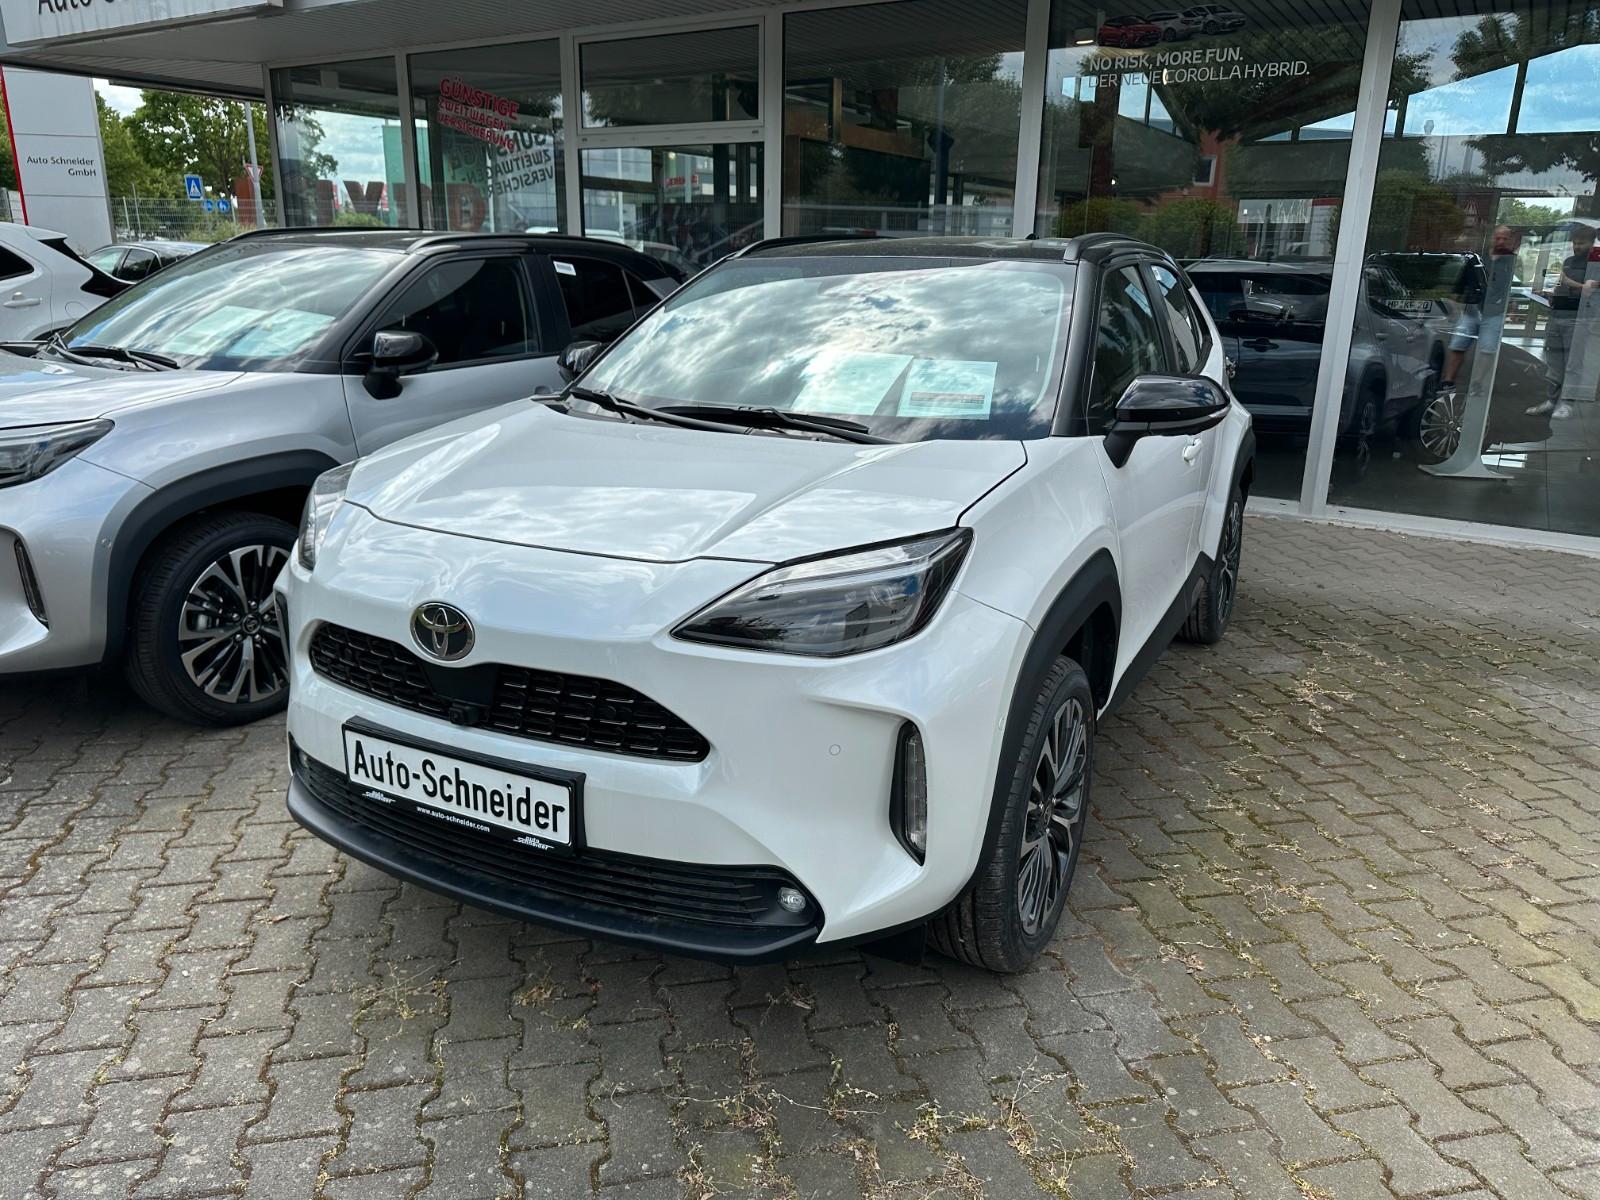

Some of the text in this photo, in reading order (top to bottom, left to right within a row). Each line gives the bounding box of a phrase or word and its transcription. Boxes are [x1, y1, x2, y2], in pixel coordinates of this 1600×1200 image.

[1089, 47, 1244, 71] NO RISK, MORE FUN.
[1089, 60, 1310, 88] DER NEUE COROLLA HYBRID.
[441, 77, 519, 121] GÜNSTIGE
[26, 155, 95, 166] Auto Schneider
[68, 168, 97, 177] GmbH
[354, 740, 566, 833] Auto-Schneider
[416, 806, 491, 833] www.auto-schneider.com
